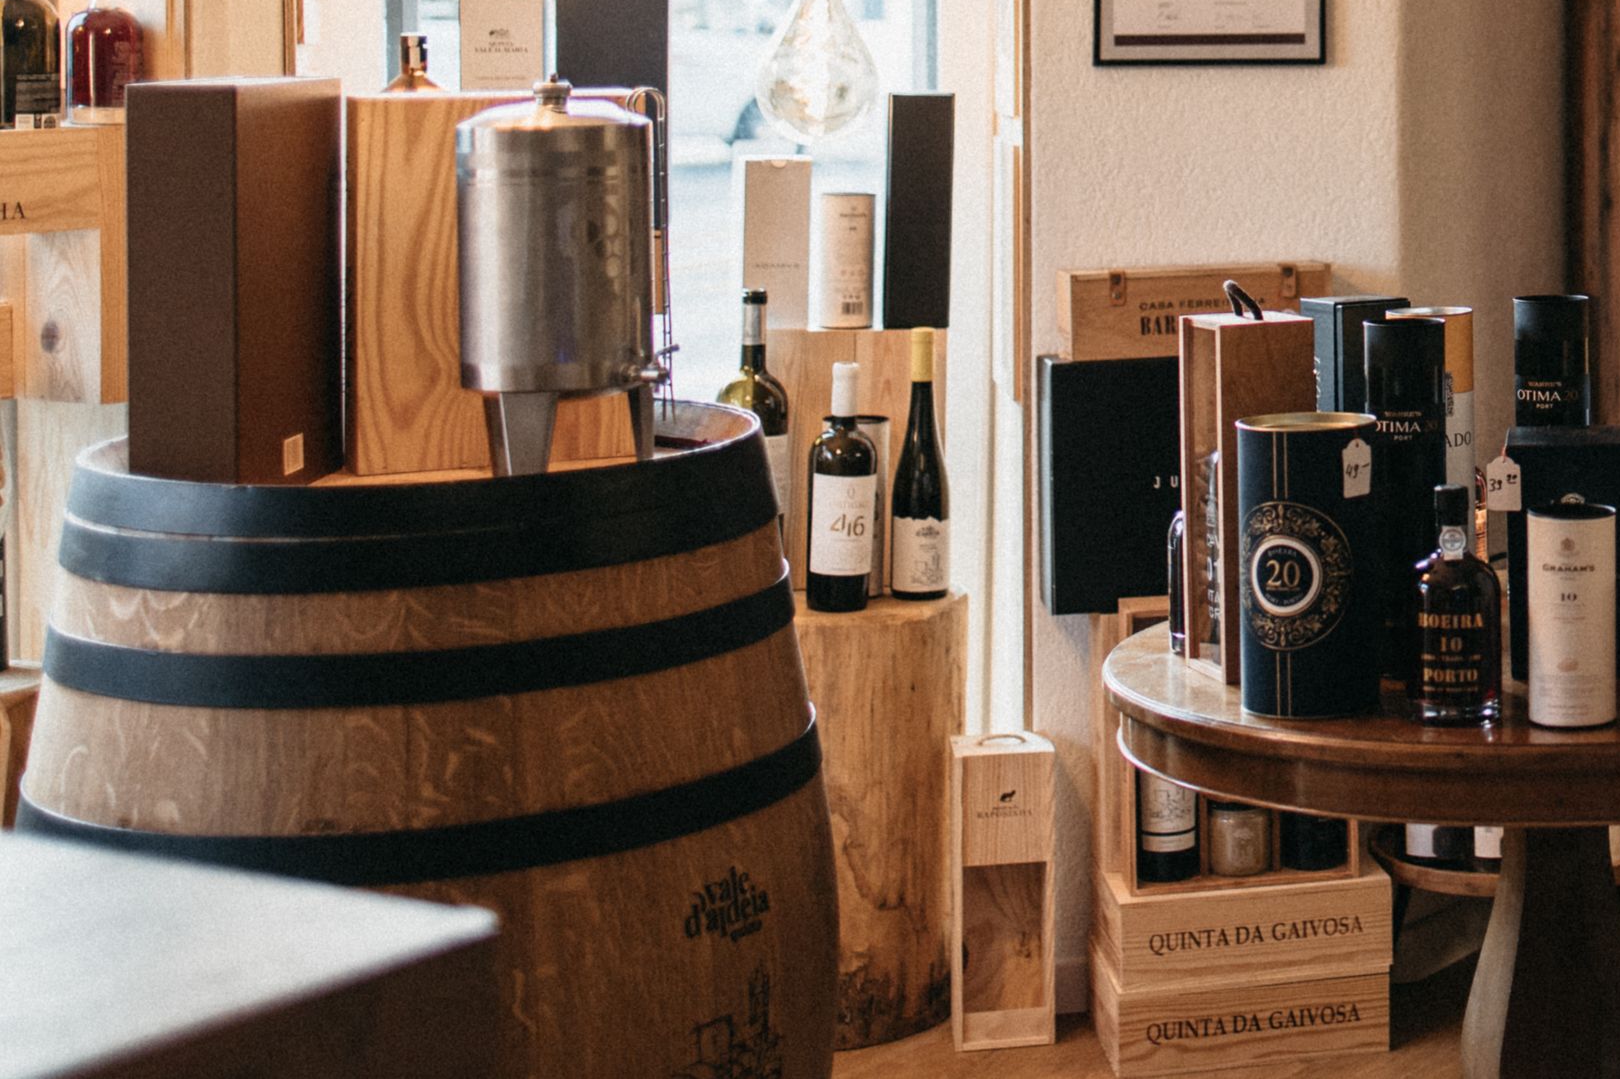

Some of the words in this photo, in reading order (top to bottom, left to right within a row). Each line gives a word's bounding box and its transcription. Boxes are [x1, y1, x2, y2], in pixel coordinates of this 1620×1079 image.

[1139, 300, 1174, 311] CASA
[1140, 316, 1177, 336] BAR
[1517, 389, 1562, 402] OTIMA
[1265, 559, 1301, 587] 20
[1542, 562, 1596, 573] GRAHAM'S
[1560, 592, 1578, 602] 10
[1418, 612, 1484, 629] BOEIRA
[1440, 636, 1463, 653] 10
[1423, 667, 1479, 683] PORTO
[1149, 928, 1230, 956] QUINTA
[1236, 925, 1265, 945] DA
[1271, 915, 1364, 942] GAIVOSA
[1146, 1015, 1227, 1046] QUINTA
[1232, 1014, 1262, 1035] DA
[1268, 1003, 1361, 1030] GAIVOSA
